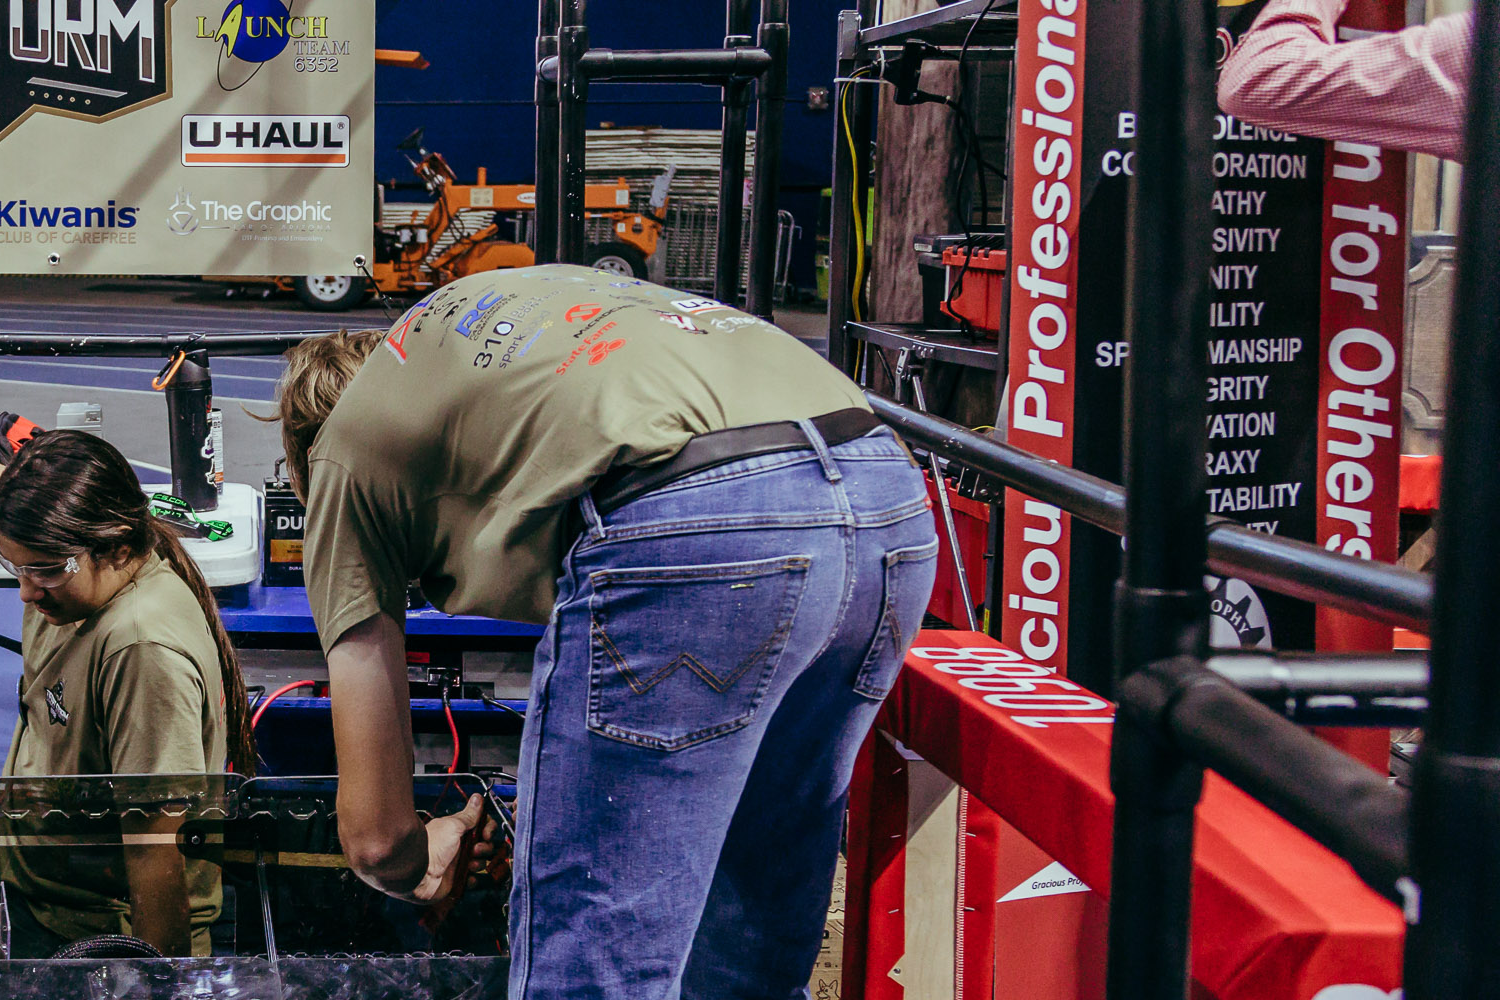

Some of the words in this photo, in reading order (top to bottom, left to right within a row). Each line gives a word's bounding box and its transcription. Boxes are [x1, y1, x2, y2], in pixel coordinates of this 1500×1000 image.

[293, 41, 350, 56] TEAM
[293, 56, 339, 73] 6352
[189, 121, 344, 148] U-HAUL
[200, 200, 244, 221] The
[246, 200, 332, 224] Graphic
[36, 231, 59, 244] OF
[61, 231, 138, 244] CAREFREE
[1330, 203, 1399, 312] for
[454, 289, 505, 338] RC
[473, 318, 516, 370] 310
[909, 646, 1119, 729] 10988
[1031, 878, 1066, 890] Gracious
